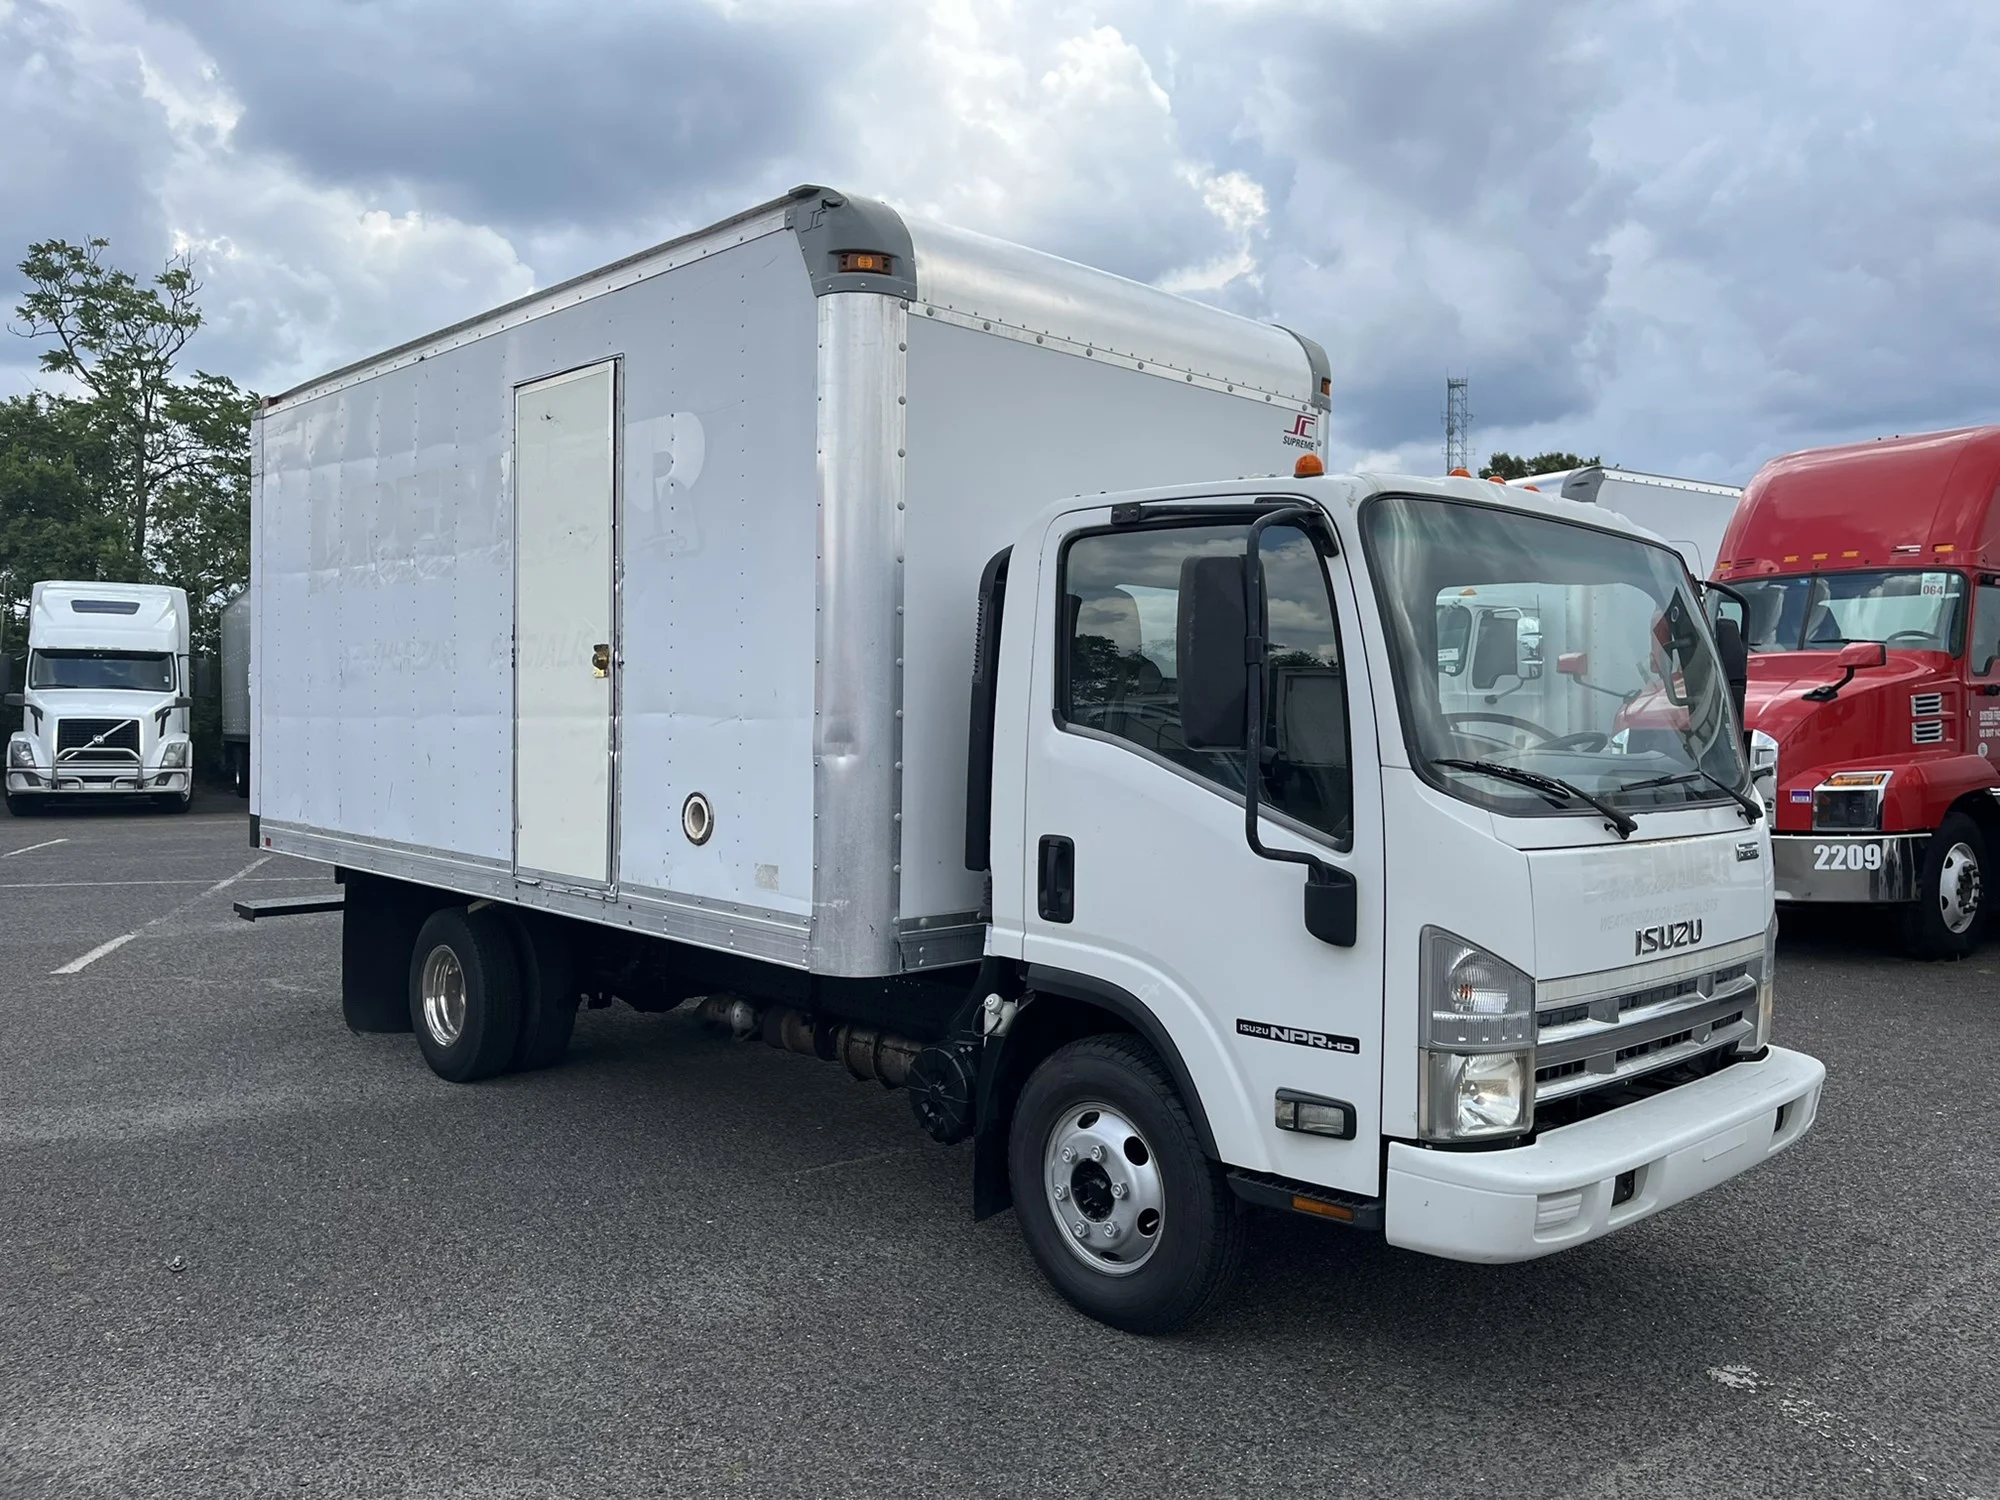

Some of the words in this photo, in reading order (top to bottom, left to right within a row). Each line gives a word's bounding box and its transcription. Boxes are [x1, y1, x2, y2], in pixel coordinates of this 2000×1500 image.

[1283, 436, 1315, 451] SUPREME
[1813, 844, 1881, 870] 2209
[1635, 918, 1702, 956] ISUZU
[1240, 1024, 1269, 1035] ISUZU
[1270, 1026, 1327, 1047] NPR
[1328, 1041, 1354, 1051] HD
